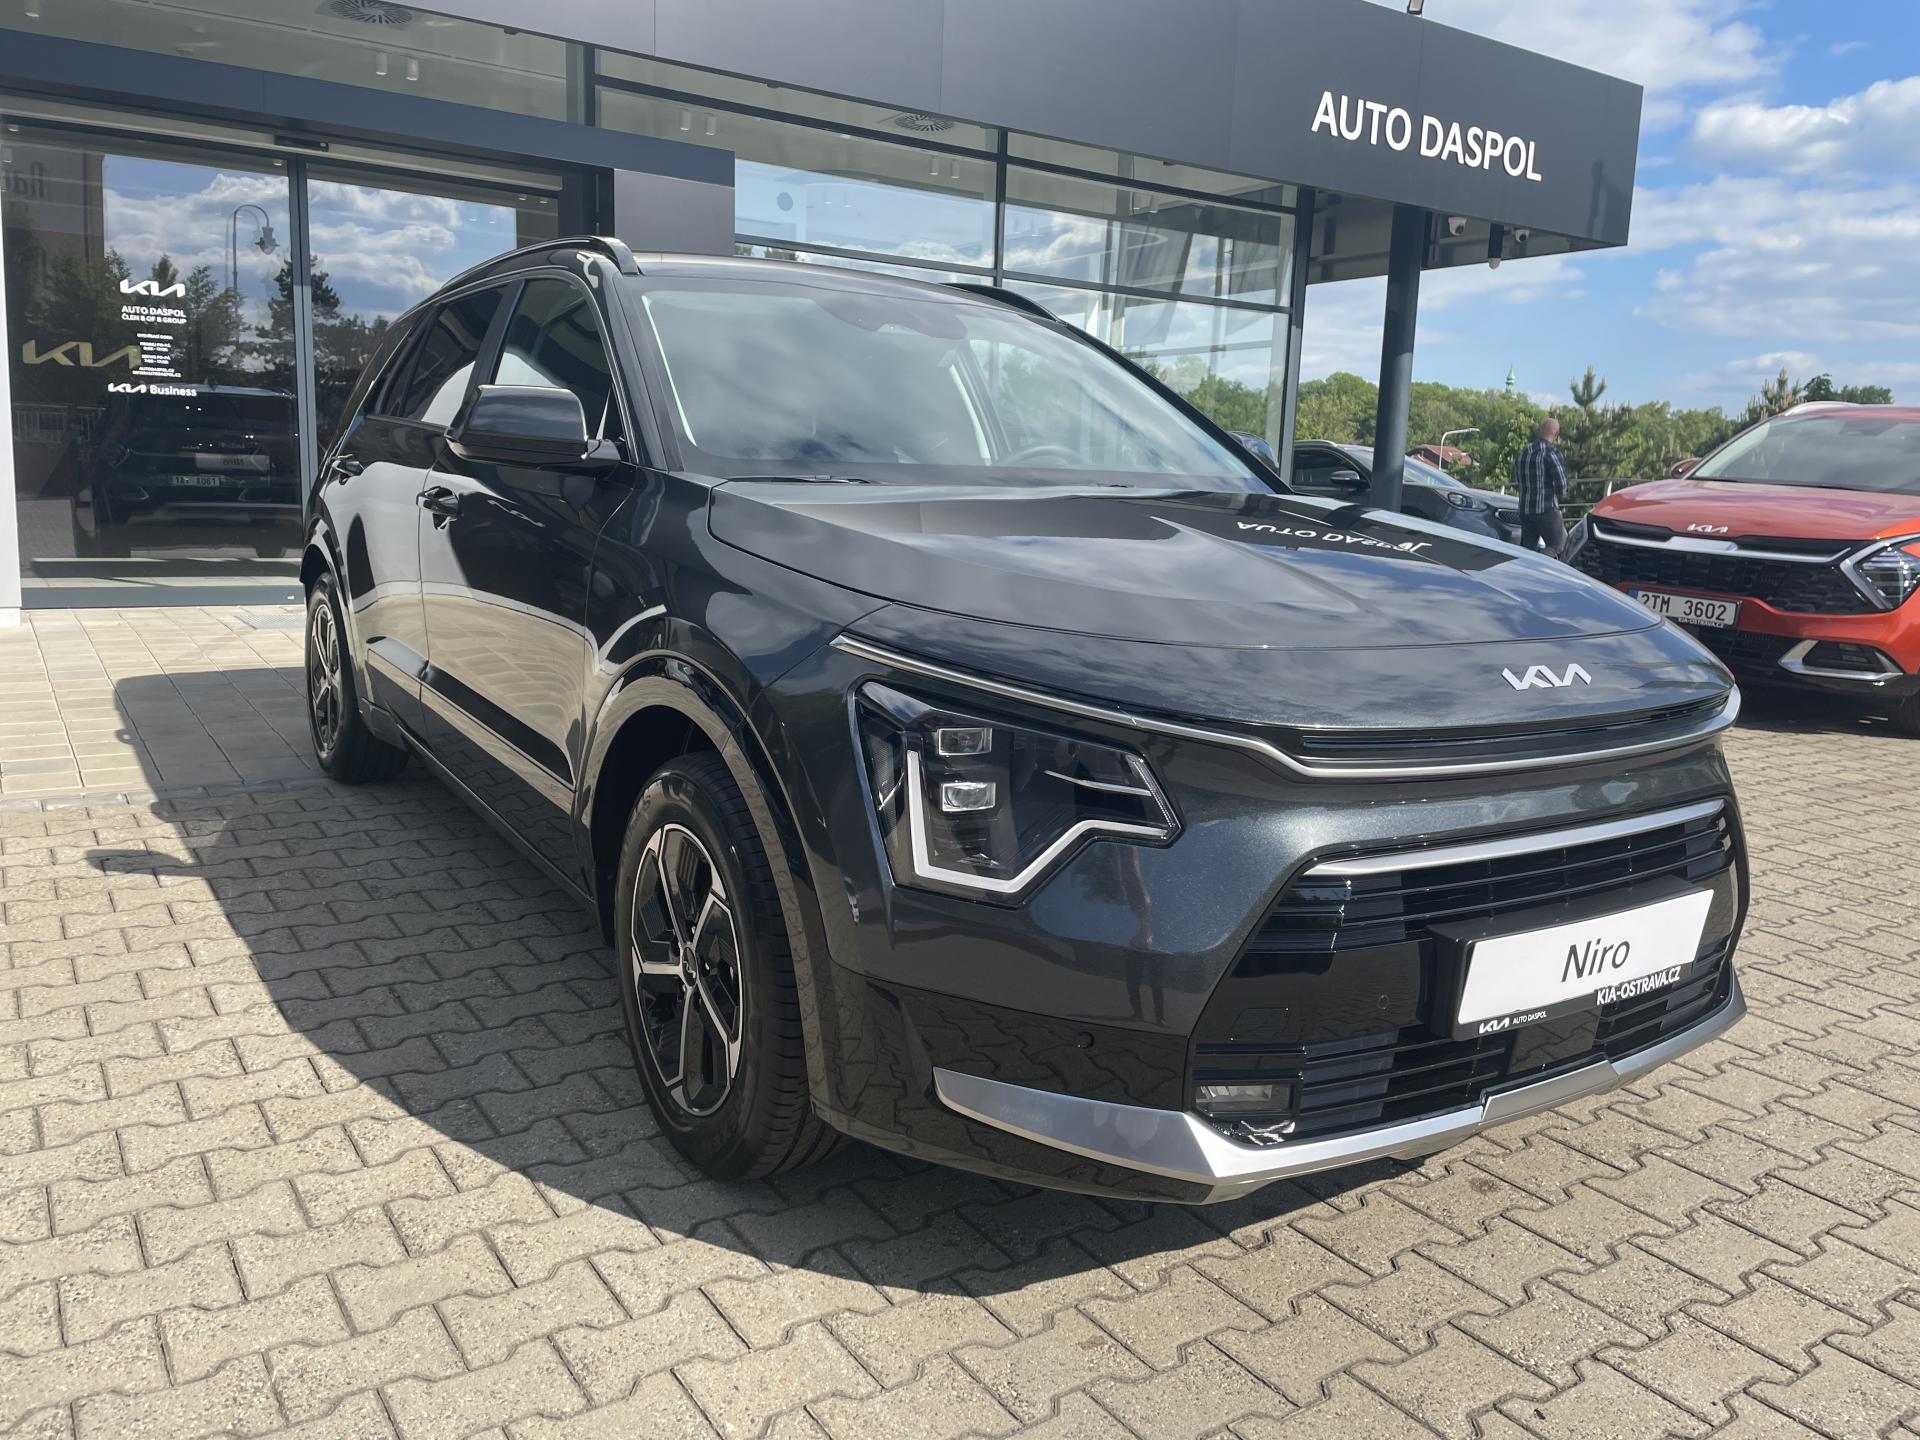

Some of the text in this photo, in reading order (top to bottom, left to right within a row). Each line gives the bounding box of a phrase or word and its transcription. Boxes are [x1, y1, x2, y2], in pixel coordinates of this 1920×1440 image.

[1311, 90, 1542, 182] AUTO DASPOL
[119, 278, 186, 298] KIA
[121, 305, 187, 318] AUTO DASPOL
[121, 312, 140, 321] ČLEN
[22, 339, 141, 369] KIA
[107, 383, 198, 397] KIA Business
[1687, 523, 1729, 534] KIA
[1683, 600, 1727, 621] 3602
[1501, 663, 1592, 691] KIA
[1560, 937, 1631, 983] Niro
[1596, 966, 1682, 1006] KIA-OSTRAVA.CZ
[1479, 1010, 1547, 1034] KIA AUTO DASPOL
